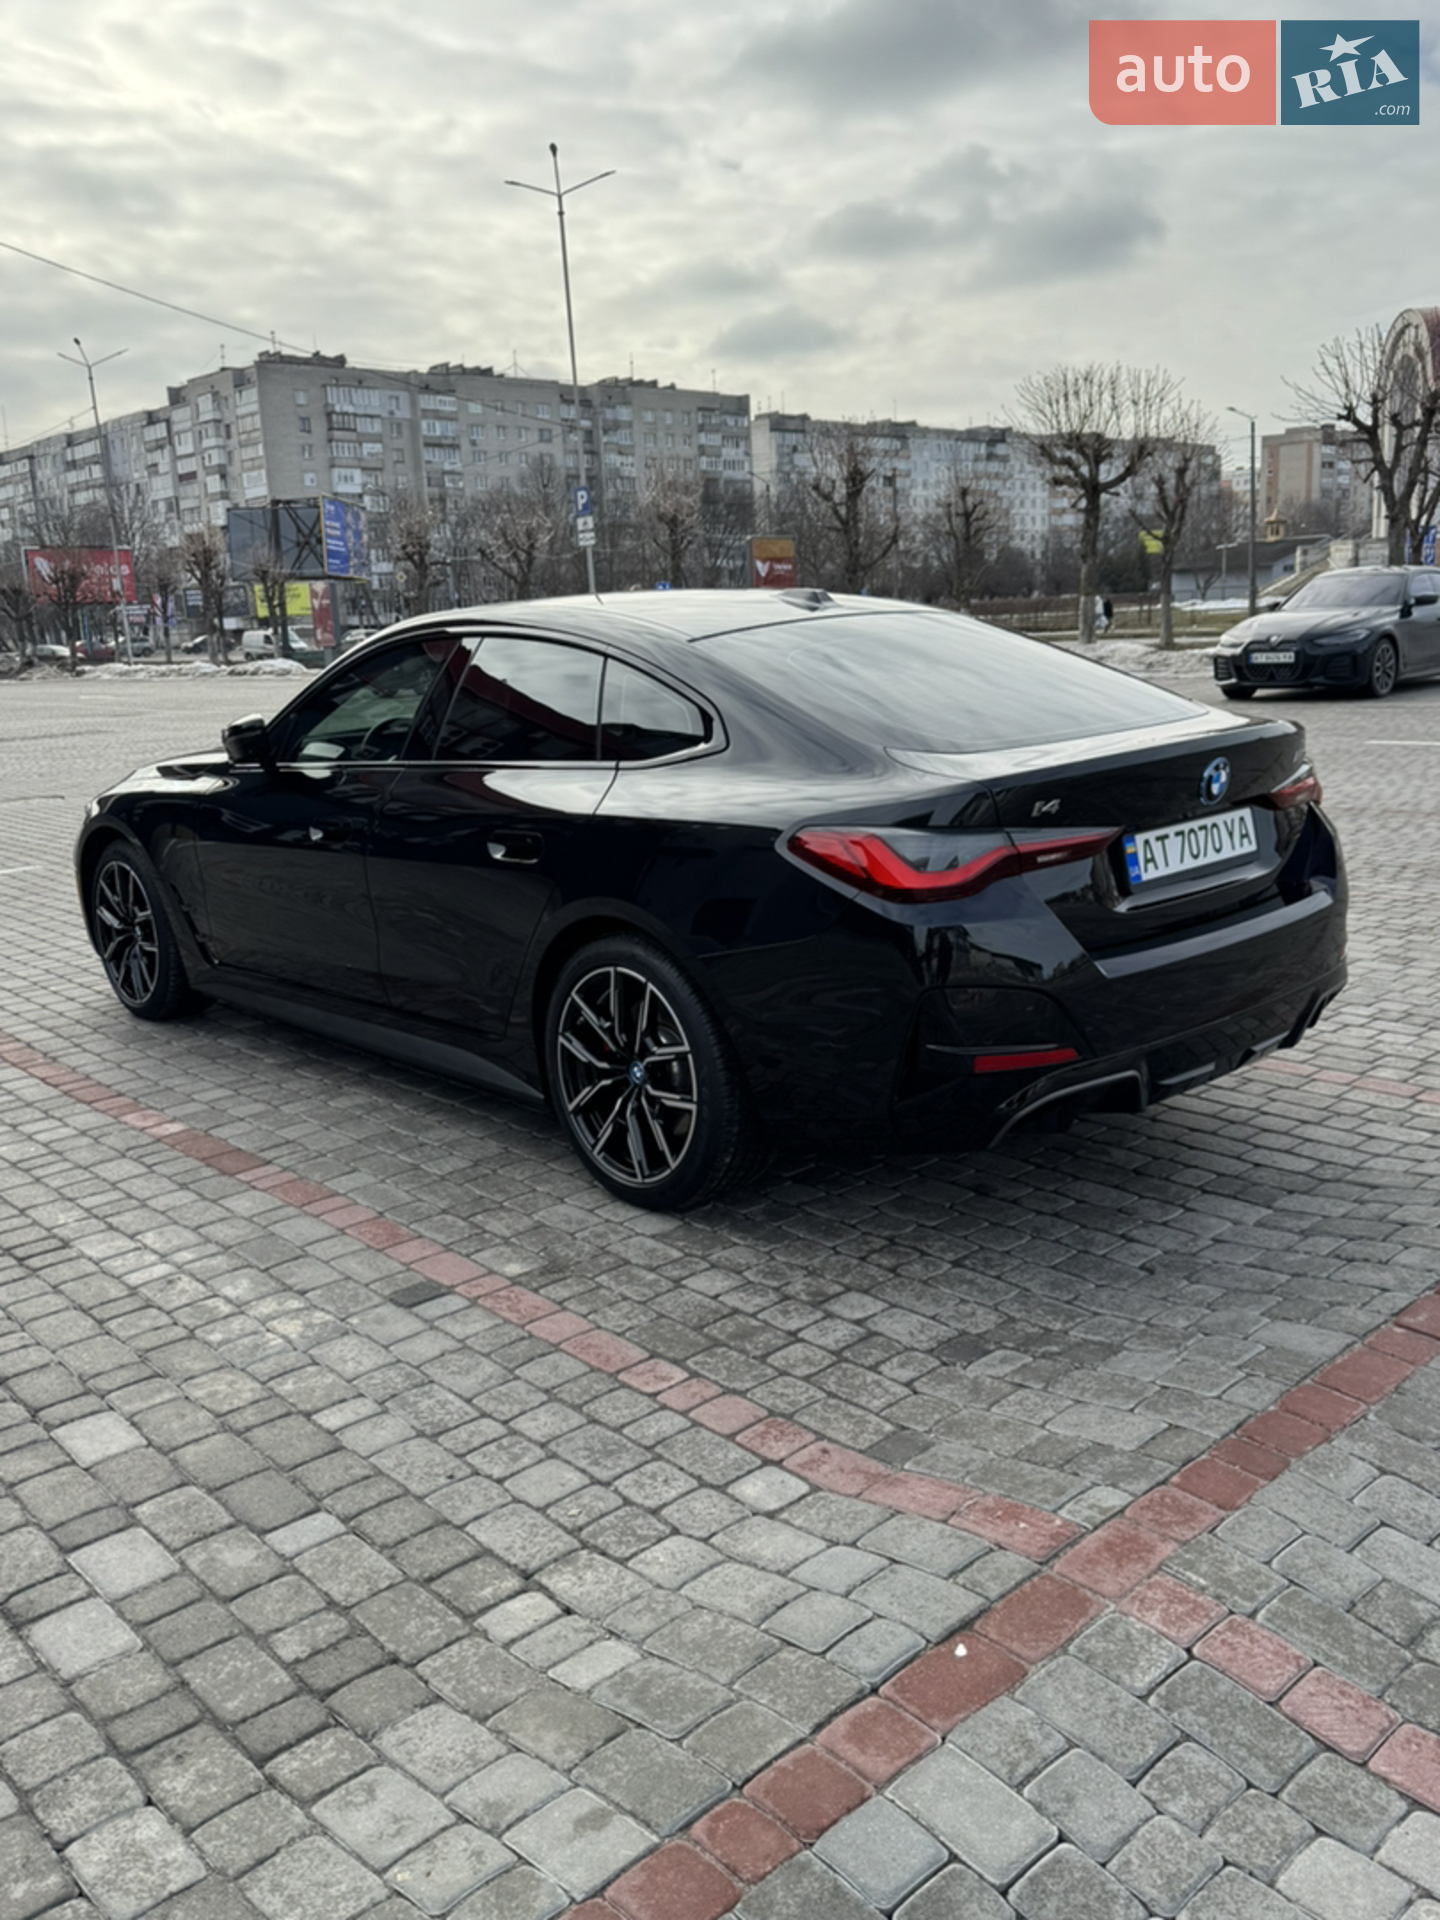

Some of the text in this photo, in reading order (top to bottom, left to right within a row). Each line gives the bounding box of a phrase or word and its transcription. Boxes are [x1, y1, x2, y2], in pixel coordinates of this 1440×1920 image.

[577, 490, 588, 511] P
[1142, 815, 1252, 873] AT 7070 YA
